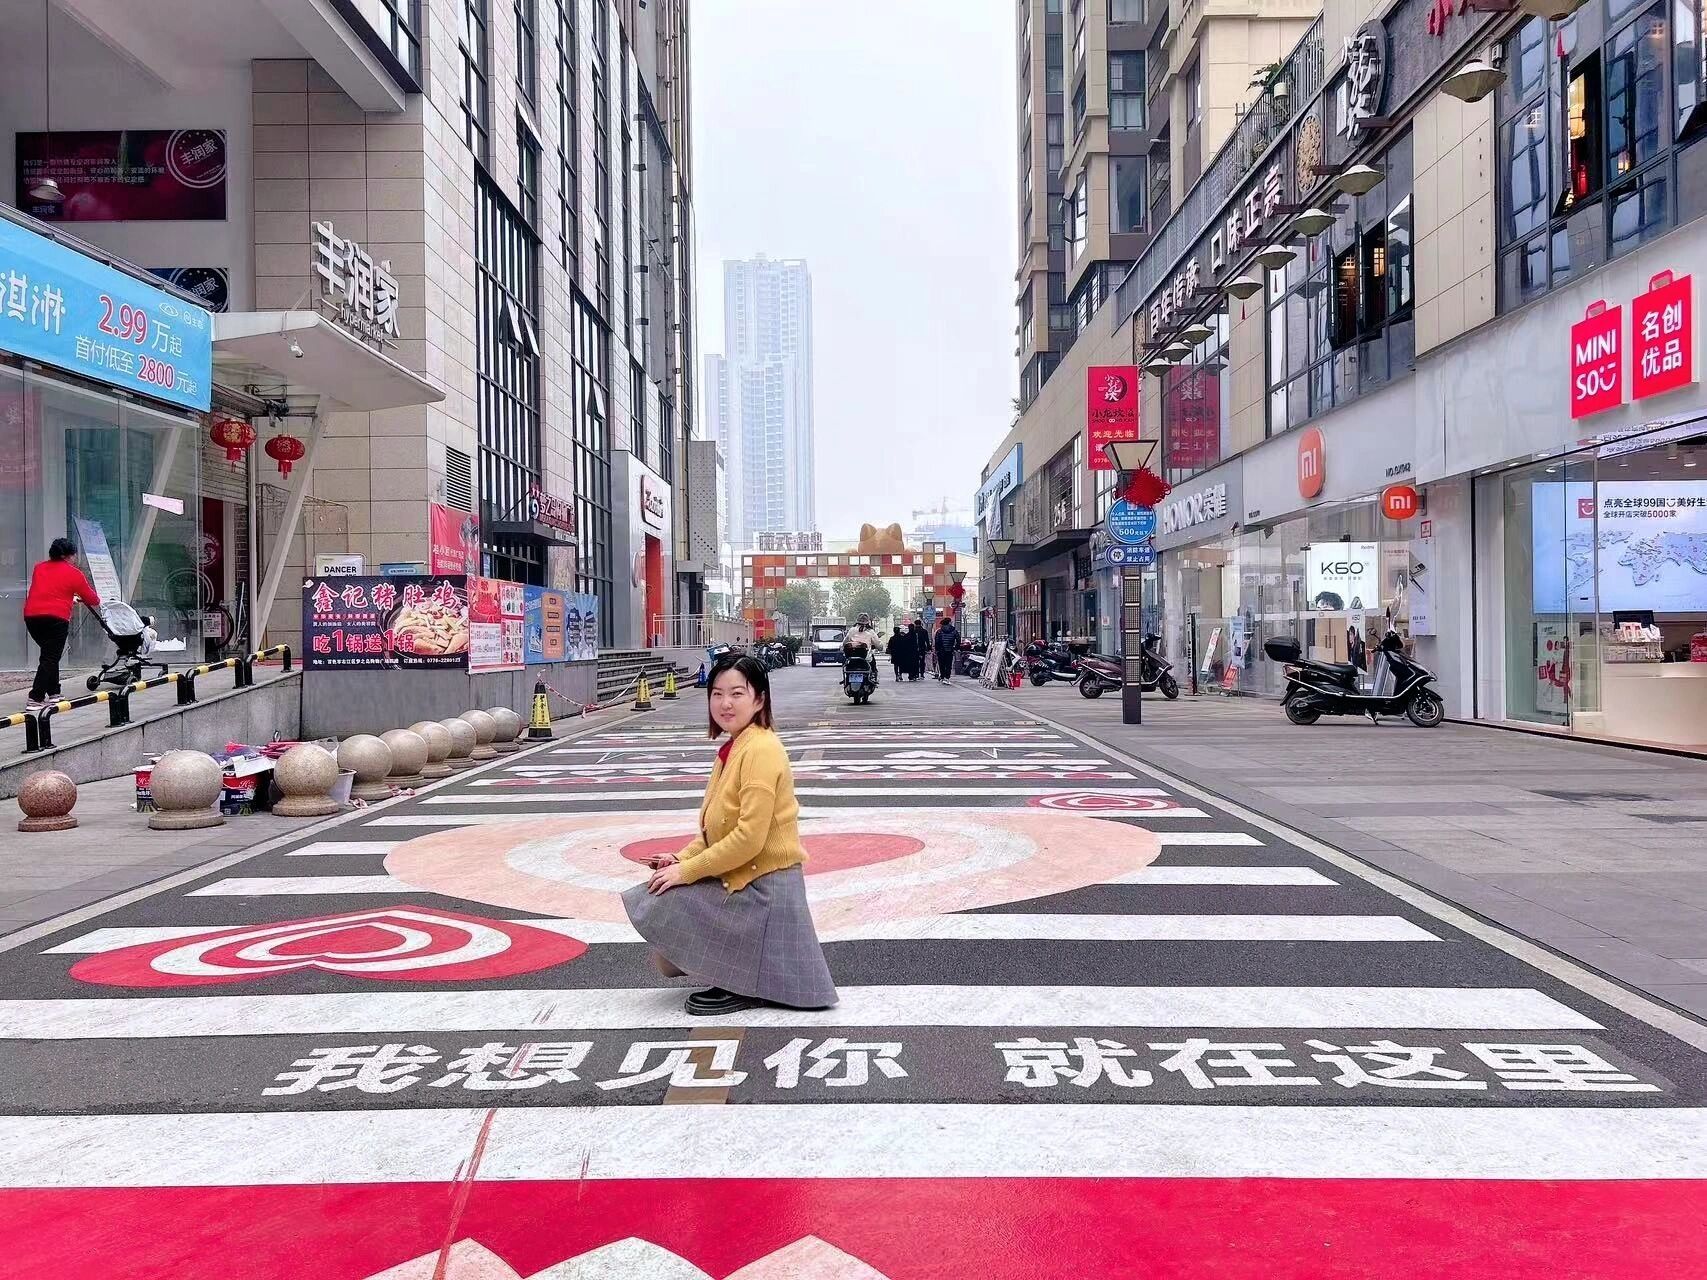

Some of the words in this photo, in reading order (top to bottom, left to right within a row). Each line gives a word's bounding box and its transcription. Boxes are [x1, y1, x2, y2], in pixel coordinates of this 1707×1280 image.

[180, 139, 218, 165] 丰润家
[1211, 163, 1281, 274] 口味正宗
[190, 277, 219, 298] 润家
[311, 221, 400, 338] 丰润家
[1641, 300, 1683, 342] 名创
[1576, 329, 1617, 367] MINI
[1641, 338, 1683, 379] 优品
[1092, 430, 1135, 439] 欢迎光临
[1163, 491, 1203, 535] HONOR
[1202, 483, 1227, 521] 荣耀
[1603, 498, 1666, 508] 点亮全球99国
[1603, 510, 1677, 518] 全球开店突破5000家
[1321, 562, 1364, 575] K60
[311, 580, 461, 613] 鑫记猪肚鸡
[312, 629, 416, 653] 吃1锅送1锅
[261, 1037, 909, 1096] 我想见你
[994, 1037, 1663, 1093] 就在这里
